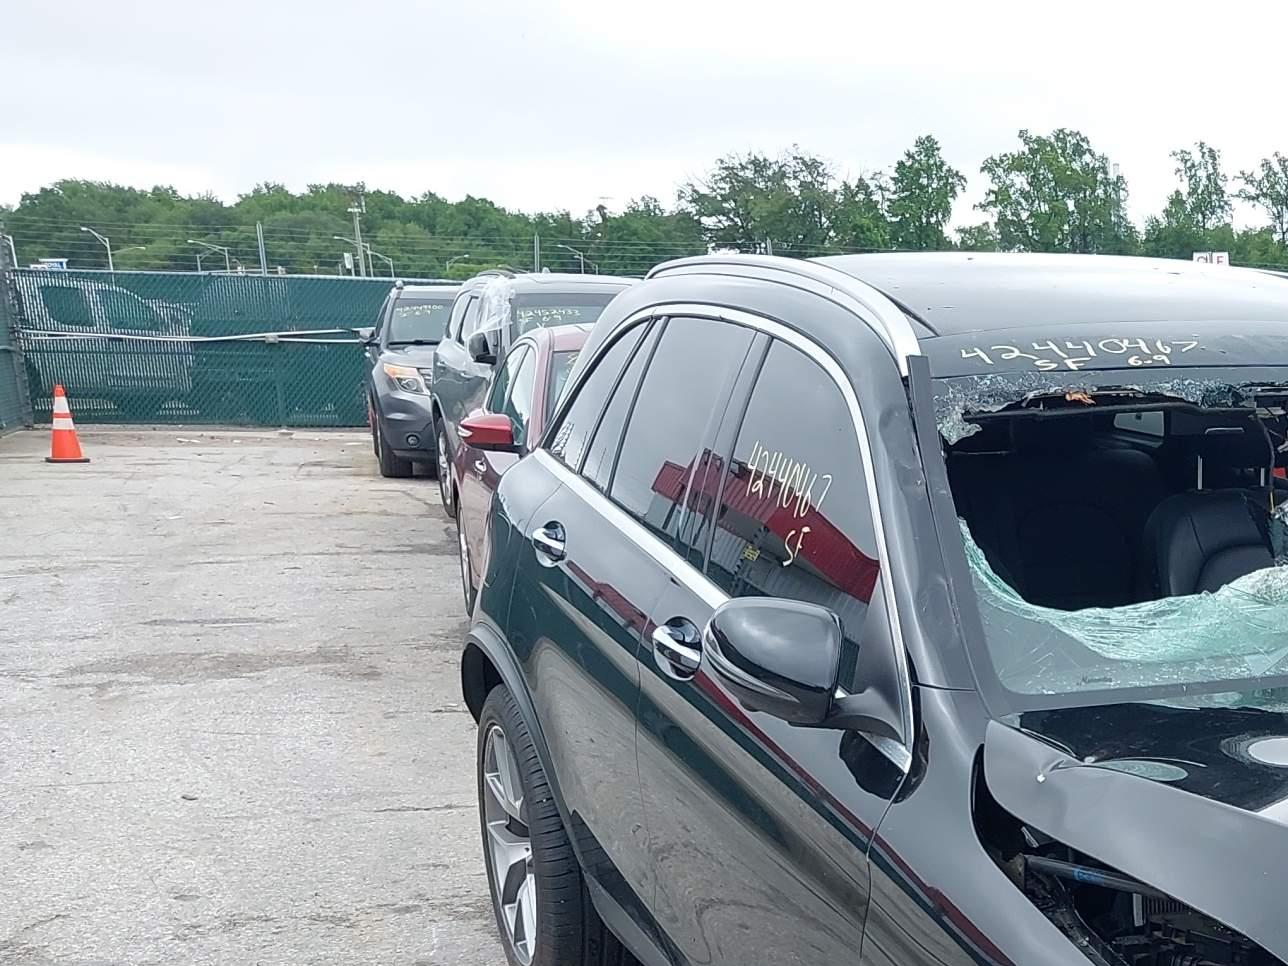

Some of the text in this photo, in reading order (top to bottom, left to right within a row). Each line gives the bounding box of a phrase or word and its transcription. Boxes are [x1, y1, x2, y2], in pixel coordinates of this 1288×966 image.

[960, 338, 1198, 365] 42440467
[1033, 356, 1092, 371] SF
[745, 440, 832, 518] 42440467
